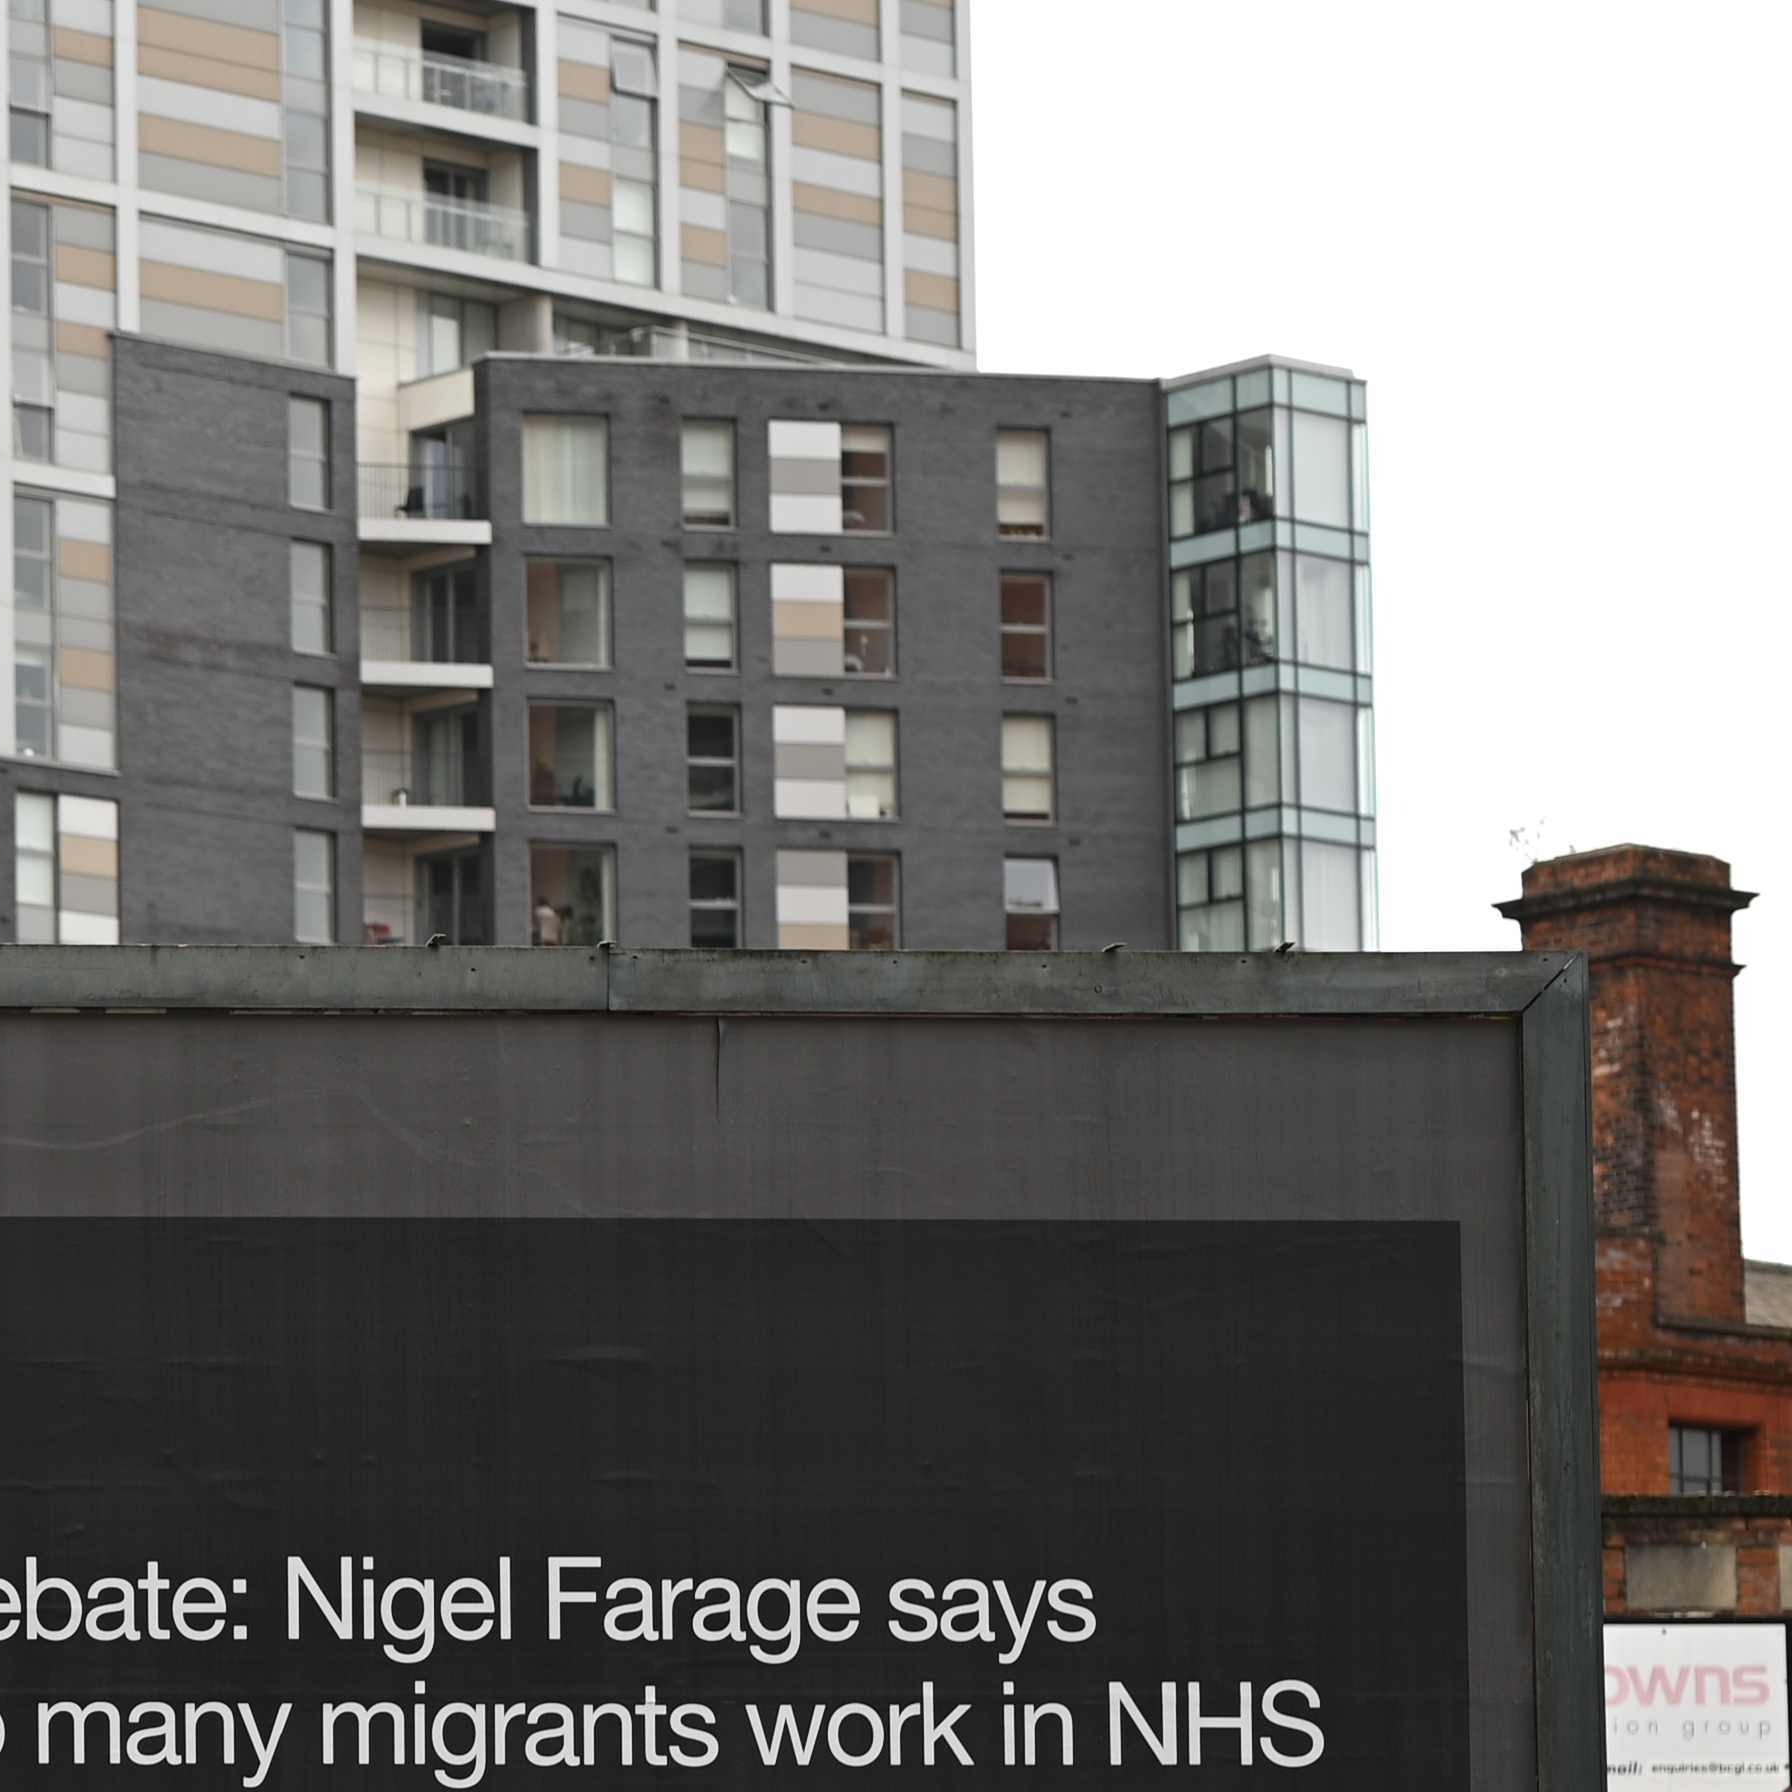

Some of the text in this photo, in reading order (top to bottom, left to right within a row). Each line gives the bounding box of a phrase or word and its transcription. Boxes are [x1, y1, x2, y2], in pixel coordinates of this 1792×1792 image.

[286, 1556, 513, 1664] Nigel
[546, 1556, 862, 1665] Farage
[888, 1578, 1098, 1665] says
[36, 1701, 294, 1788] many
[321, 1680, 720, 1789] migrants
[744, 1681, 976, 1767] work
[1002, 1681, 1075, 1766] in
[1107, 1679, 1326, 1768] NHS
[1682, 1719, 1771, 1743] group
